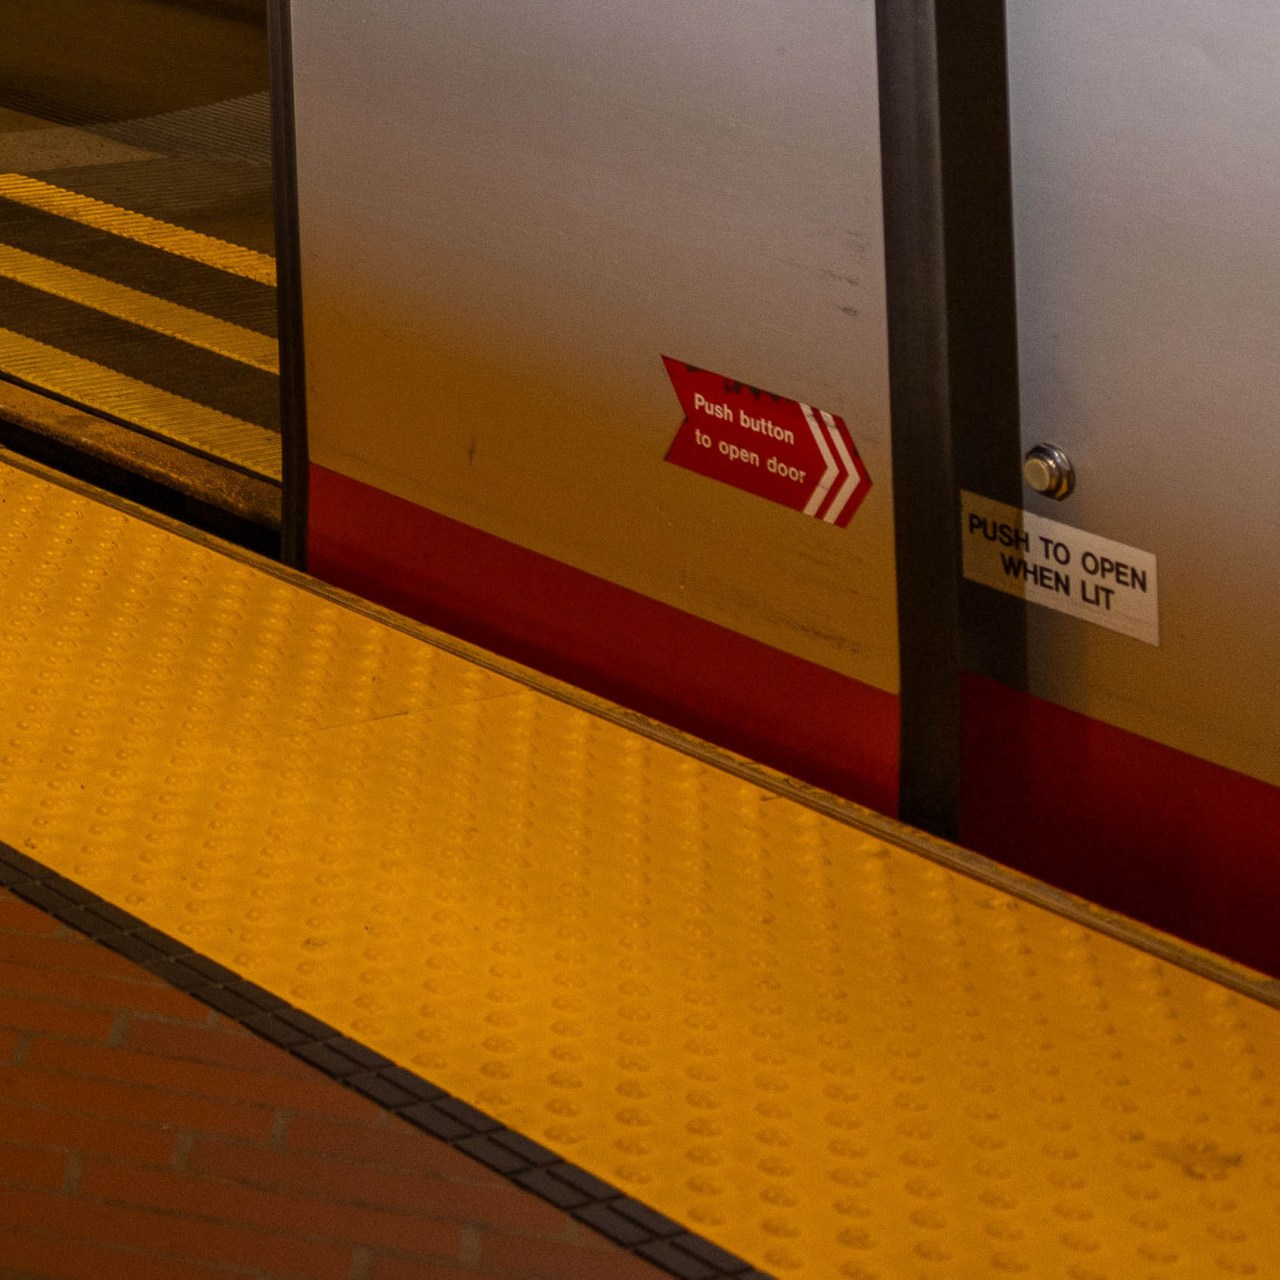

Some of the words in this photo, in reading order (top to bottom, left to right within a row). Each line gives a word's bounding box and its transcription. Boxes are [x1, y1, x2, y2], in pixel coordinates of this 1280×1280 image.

[693, 392, 734, 423] Push
[739, 409, 795, 446] button
[695, 429, 713, 449] to
[718, 441, 760, 468] open
[767, 456, 807, 484] door
[968, 513, 1030, 553] PUSH
[1039, 536, 1071, 566] TO
[1081, 551, 1148, 594] OPEN
[1000, 552, 1071, 597] WHEN
[1080, 579, 1116, 611] LIT
